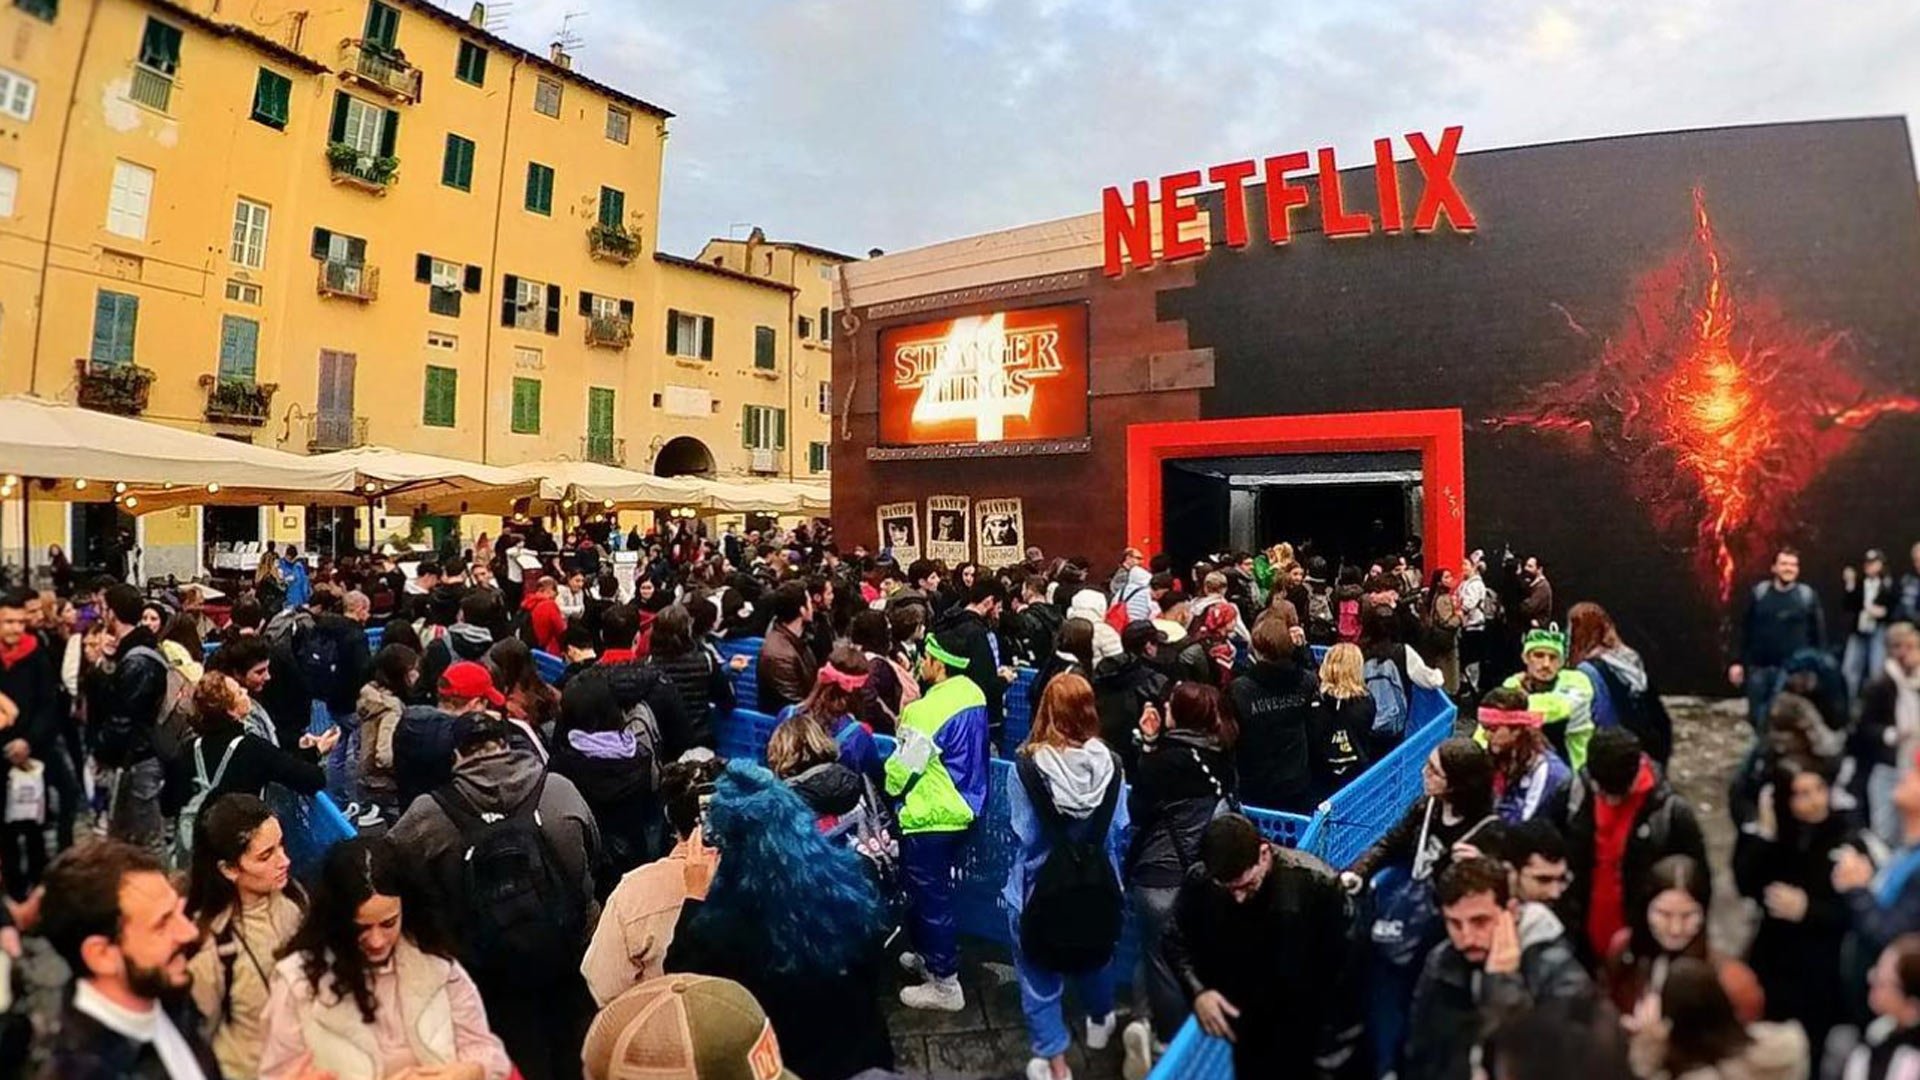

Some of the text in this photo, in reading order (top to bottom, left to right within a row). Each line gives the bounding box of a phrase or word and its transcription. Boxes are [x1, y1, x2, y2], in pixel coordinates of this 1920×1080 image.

[1102, 125, 1478, 278] NETFLIX
[894, 330, 1063, 384] STRANGER
[922, 371, 1032, 403] THINGS
[930, 497, 966, 510] WANTED
[979, 501, 1018, 514] WANTED
